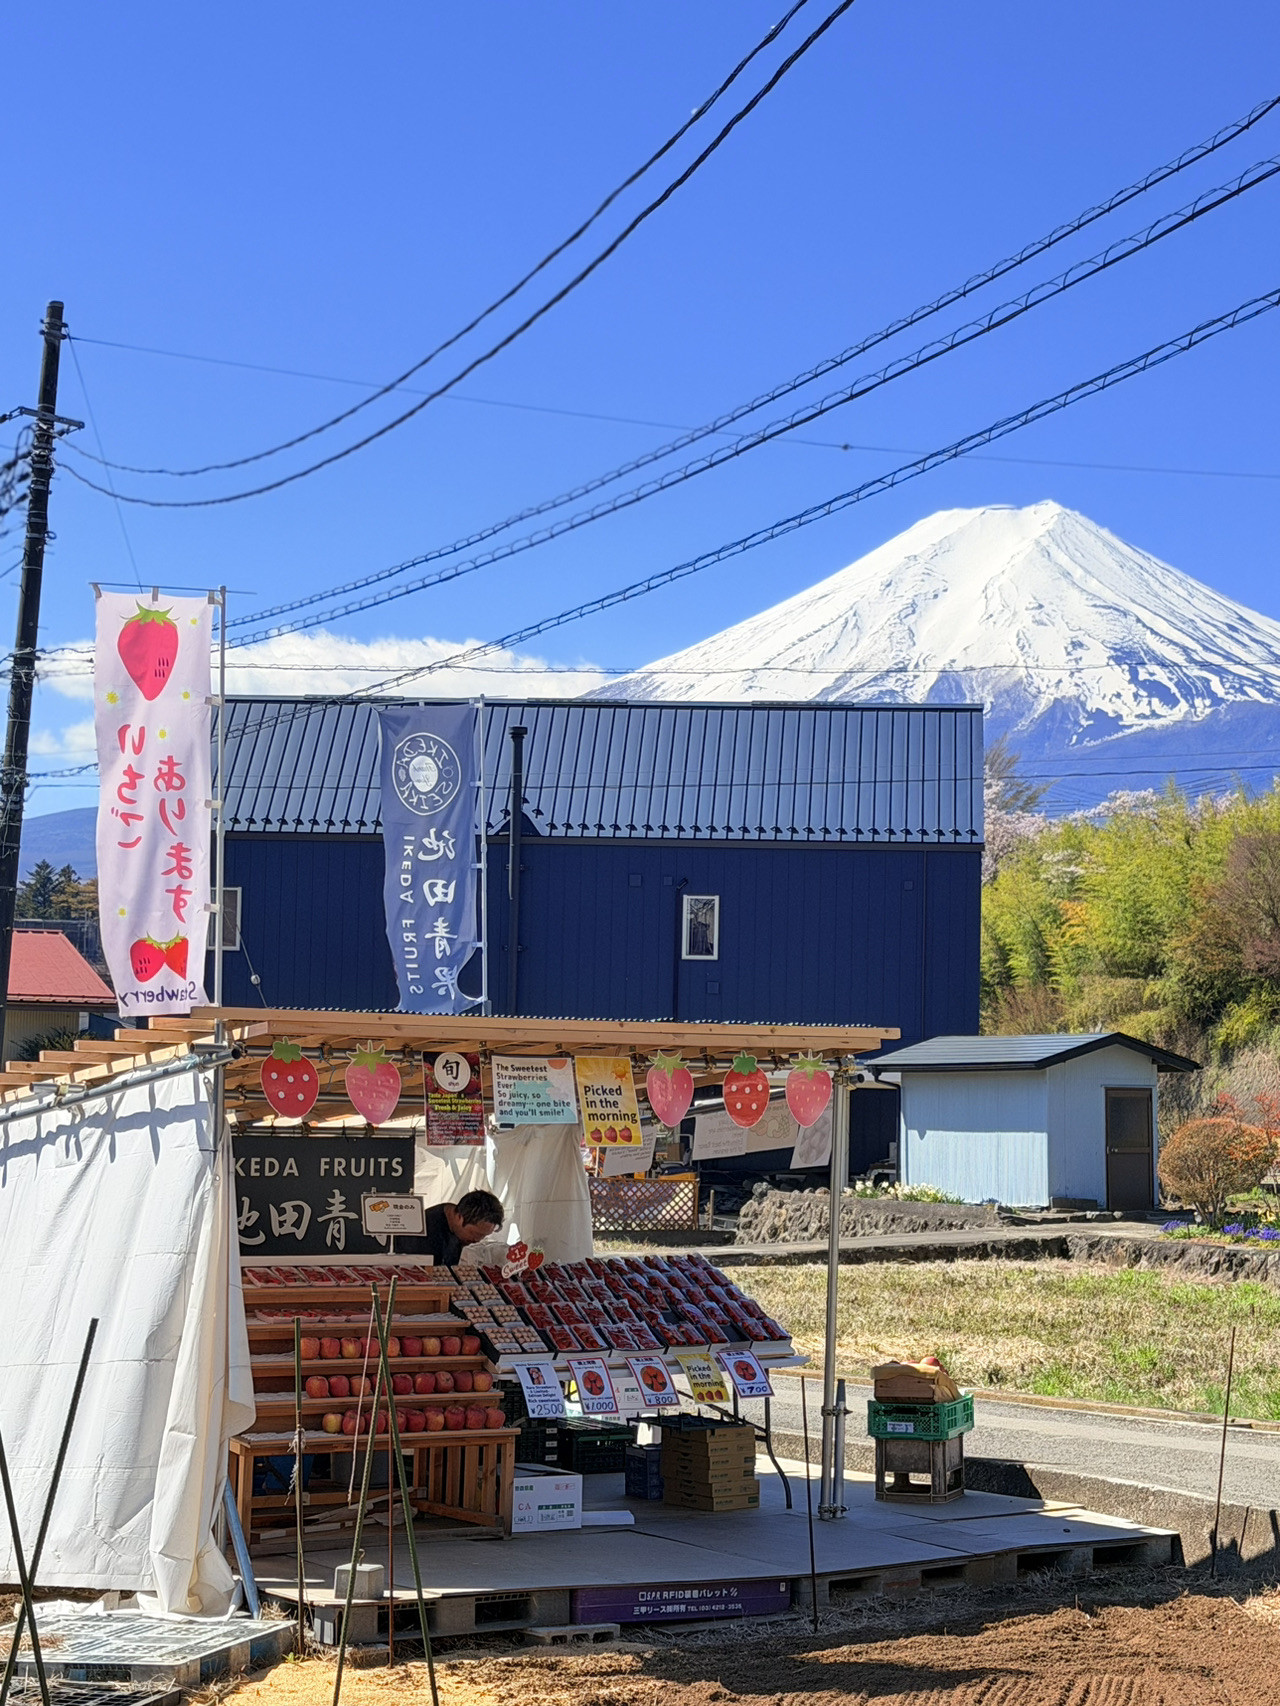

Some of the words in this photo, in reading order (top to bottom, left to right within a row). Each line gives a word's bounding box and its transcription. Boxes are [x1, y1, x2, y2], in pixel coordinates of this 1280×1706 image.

[442, 1059, 460, 1080] 旬
[496, 1063, 509, 1071] The
[511, 1064, 548, 1073] Sweetest
[496, 1072, 548, 1081] Strawberries
[497, 1081, 516, 1089] Ever!
[584, 1085, 622, 1096] Picked
[509, 1091, 530, 1100] juicy,
[553, 1100, 571, 1108] bite
[585, 1097, 597, 1108] in
[599, 1097, 619, 1108] the
[515, 1109, 537, 1118] you'll
[588, 1110, 638, 1124] morning
[319, 1157, 403, 1177] FRUITS
[503, 1259, 528, 1277] Sweet
[687, 1364, 711, 1372] Picked
[693, 1380, 725, 1388] morning
[740, 1385, 768, 1394] ¥700
[531, 1403, 564, 1416] ¥2500
